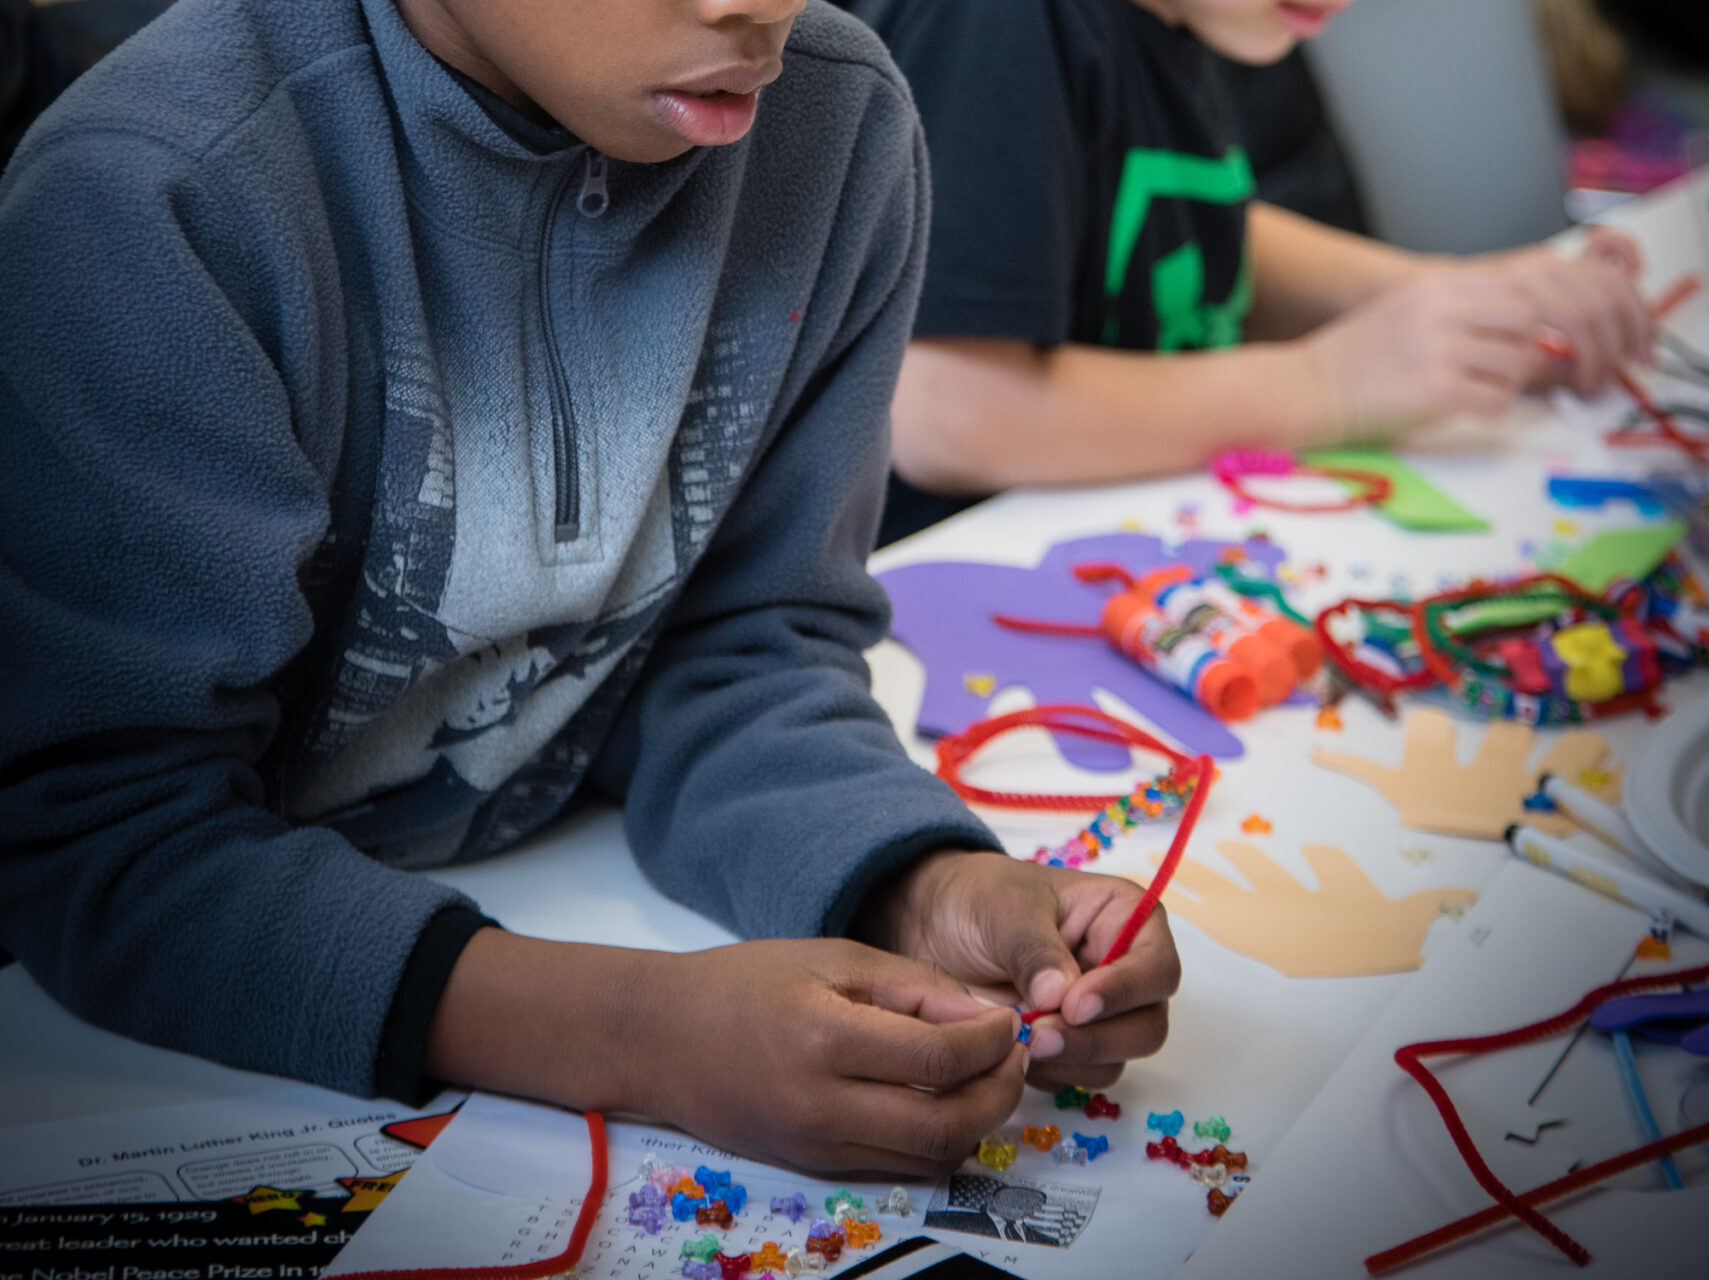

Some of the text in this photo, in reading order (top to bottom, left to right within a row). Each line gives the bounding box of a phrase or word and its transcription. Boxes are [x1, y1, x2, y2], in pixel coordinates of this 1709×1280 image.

[112, 1147, 174, 1162] Martin
[180, 1137, 242, 1152] Luther
[249, 1129, 294, 1140] King
[329, 1113, 396, 1129] Quotes
[10, 1212, 114, 1227] January
[121, 1212, 149, 1225] 15,
[156, 1209, 217, 1224] 1929
[58, 1234, 141, 1249] leader
[147, 1232, 207, 1248] who
[213, 1230, 318, 1246] wanted
[31, 1266, 115, 1280] Nobel
[122, 1266, 200, 1280] Peace
[208, 1263, 273, 1279] Prize
[280, 1263, 303, 1277] in
